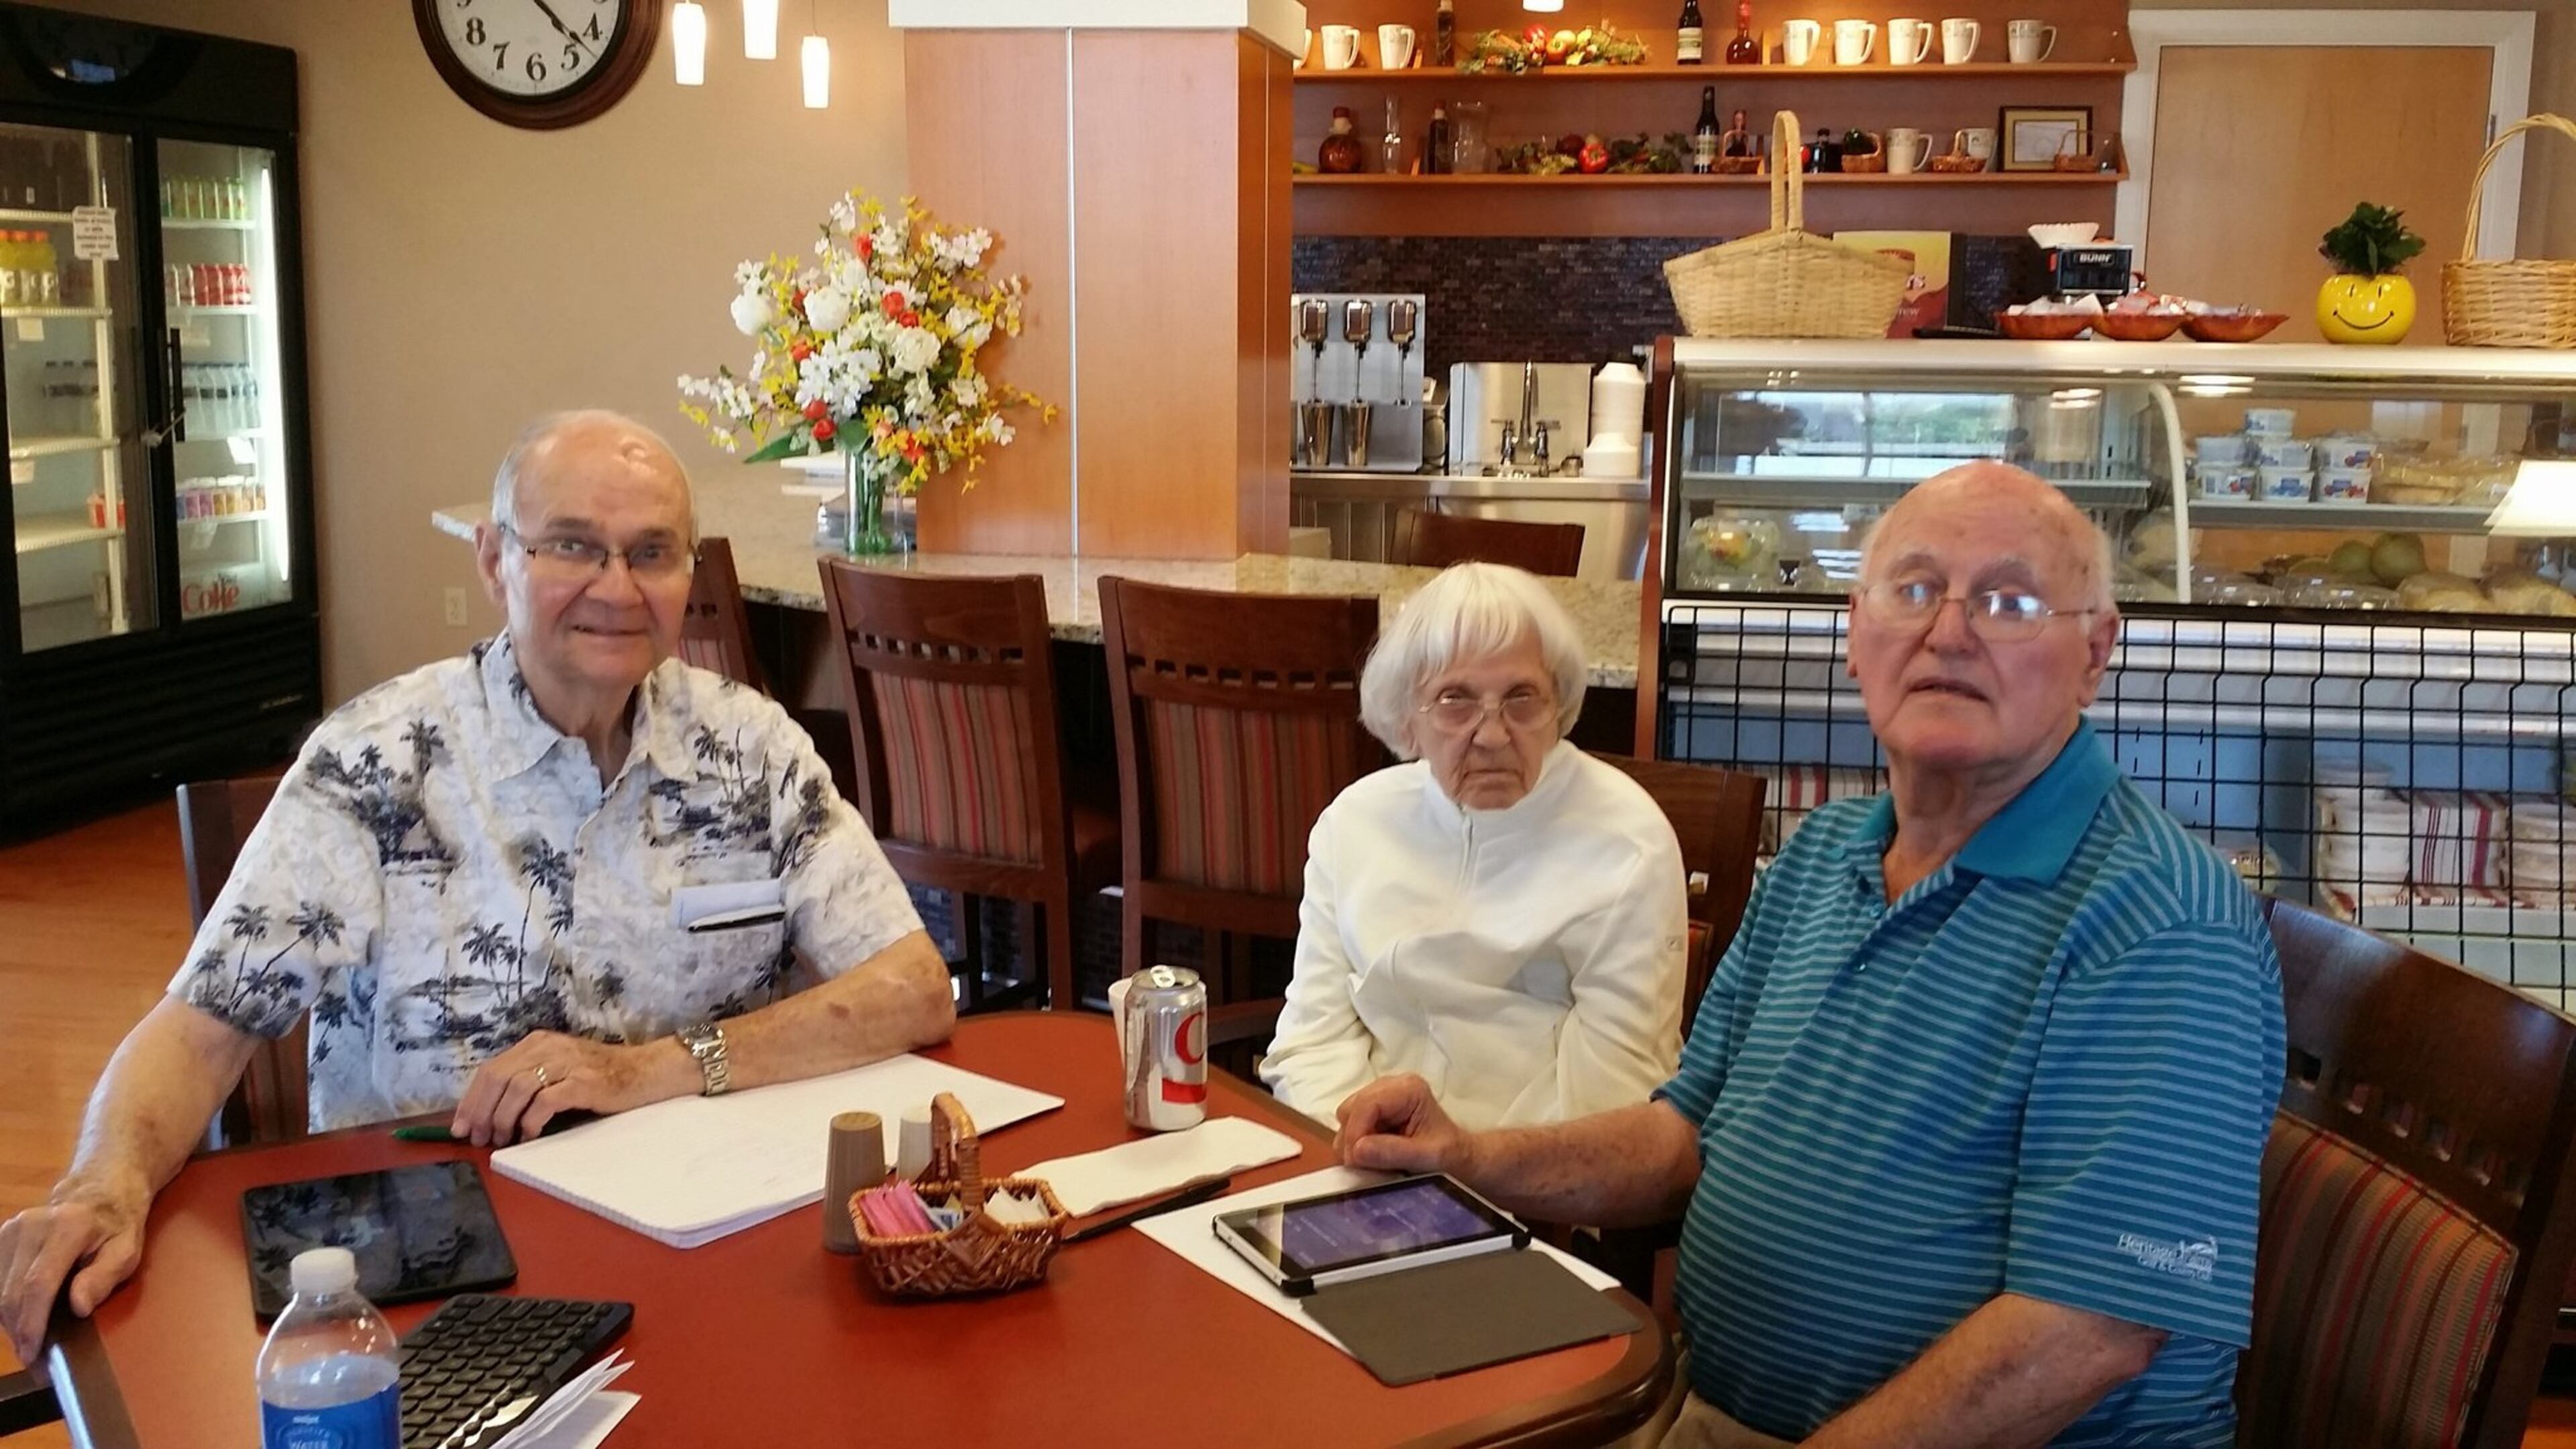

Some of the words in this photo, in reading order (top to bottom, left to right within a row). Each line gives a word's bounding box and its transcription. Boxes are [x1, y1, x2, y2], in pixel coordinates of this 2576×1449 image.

[466, 17, 486, 46] 8
[582, 13, 602, 40] 4
[493, 41, 511, 70] 7
[526, 52, 547, 81] 6
[561, 44, 580, 70] 5
